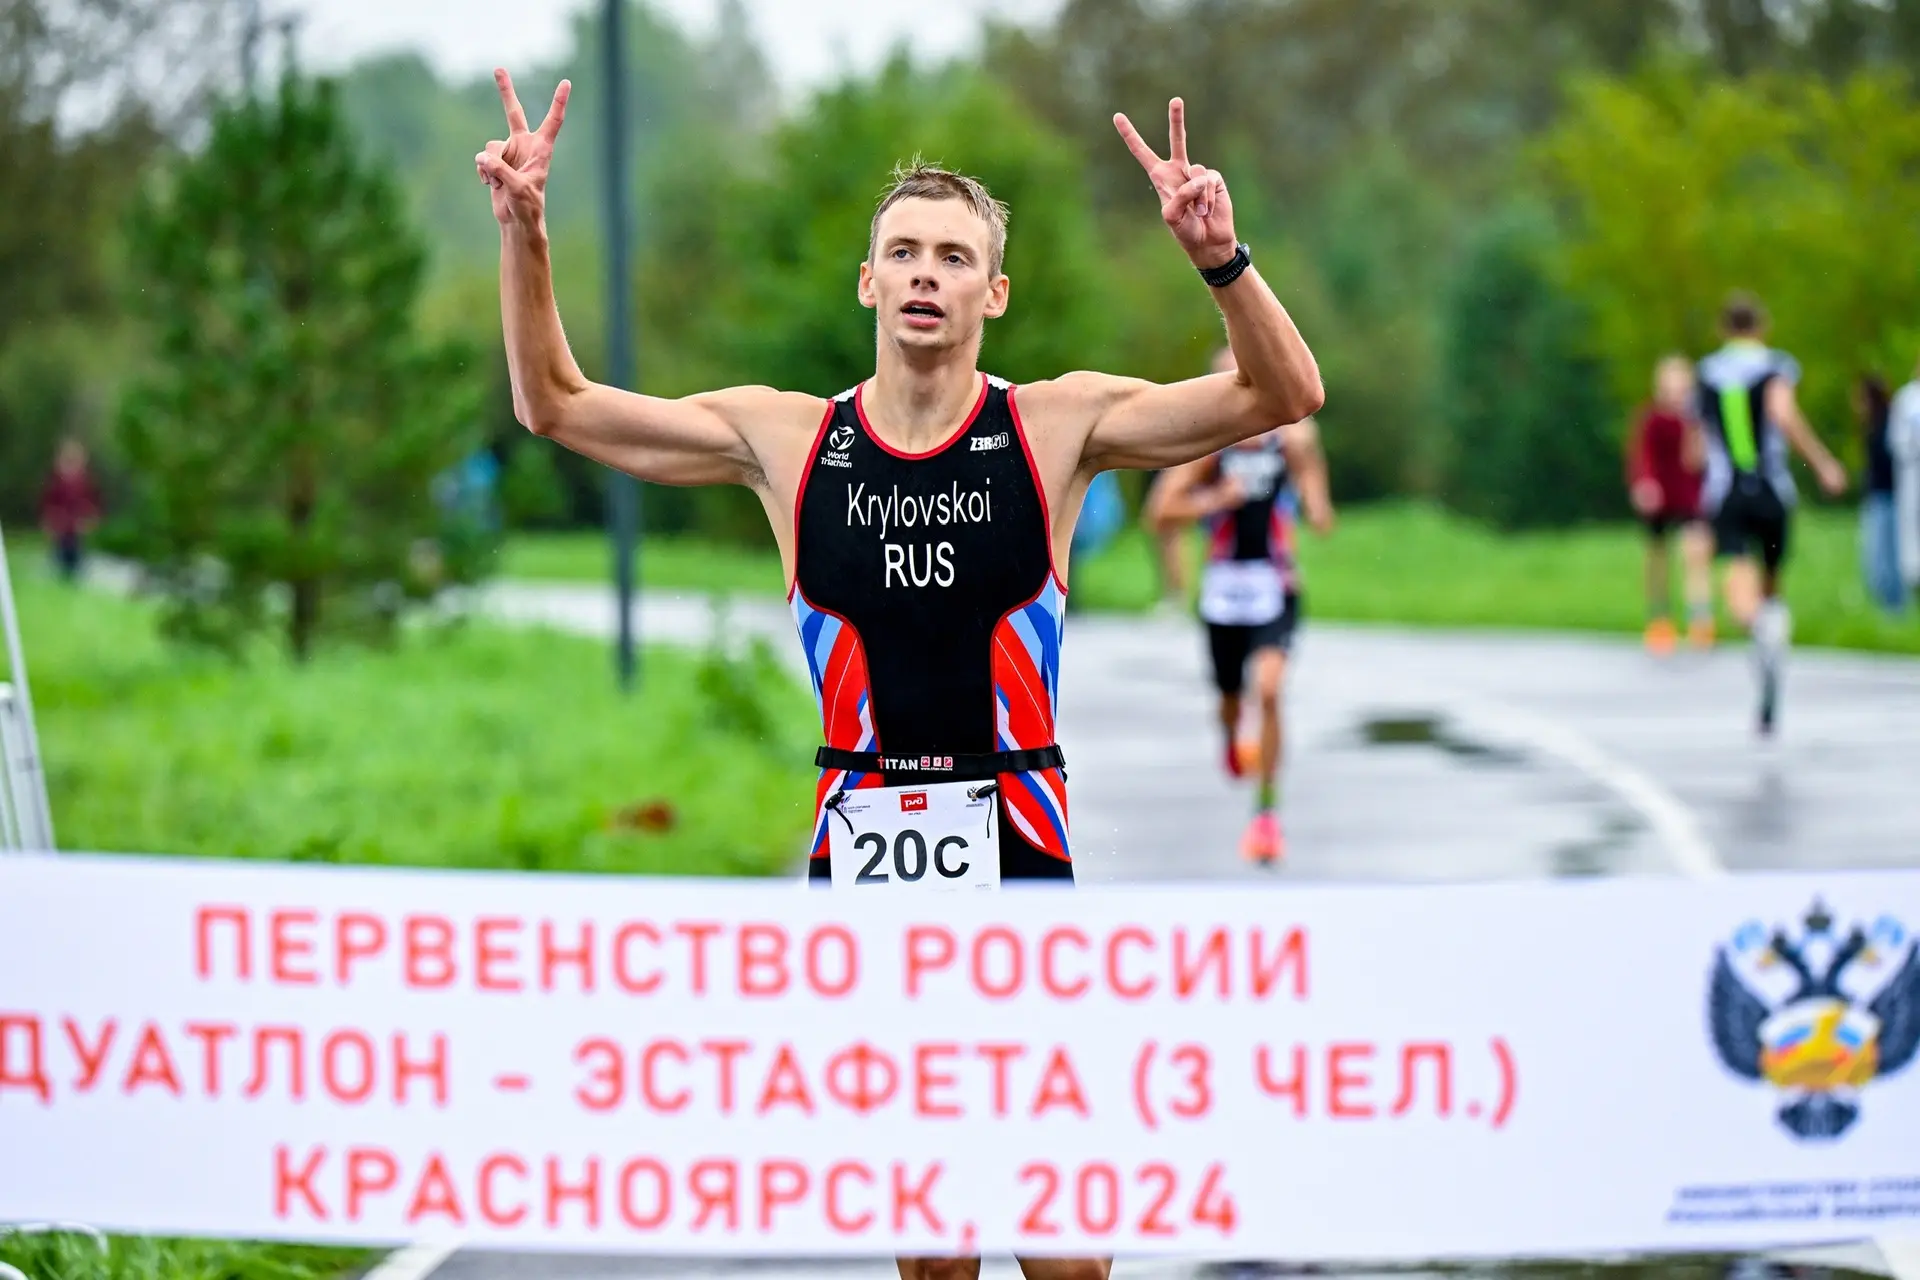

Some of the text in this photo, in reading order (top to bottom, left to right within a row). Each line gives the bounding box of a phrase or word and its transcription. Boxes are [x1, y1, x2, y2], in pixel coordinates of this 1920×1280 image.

[820, 456, 852, 468] Triathlon
[827, 450, 849, 460] World
[847, 477, 991, 539] Krylovskoi
[884, 541, 955, 588] RUS
[194, 904, 1309, 1002] ПЕРВЕНСТВО РОССИИ
[0, 1012, 451, 1106] ДУАТЛОН
[574, 1036, 1091, 1119] ЭСТАФЕТА
[1132, 1041, 1214, 1131] (3
[1254, 1037, 1518, 1129] ЧЕЛ.)
[273, 1145, 1239, 1253] КРАСНОЯРСК, 2024
